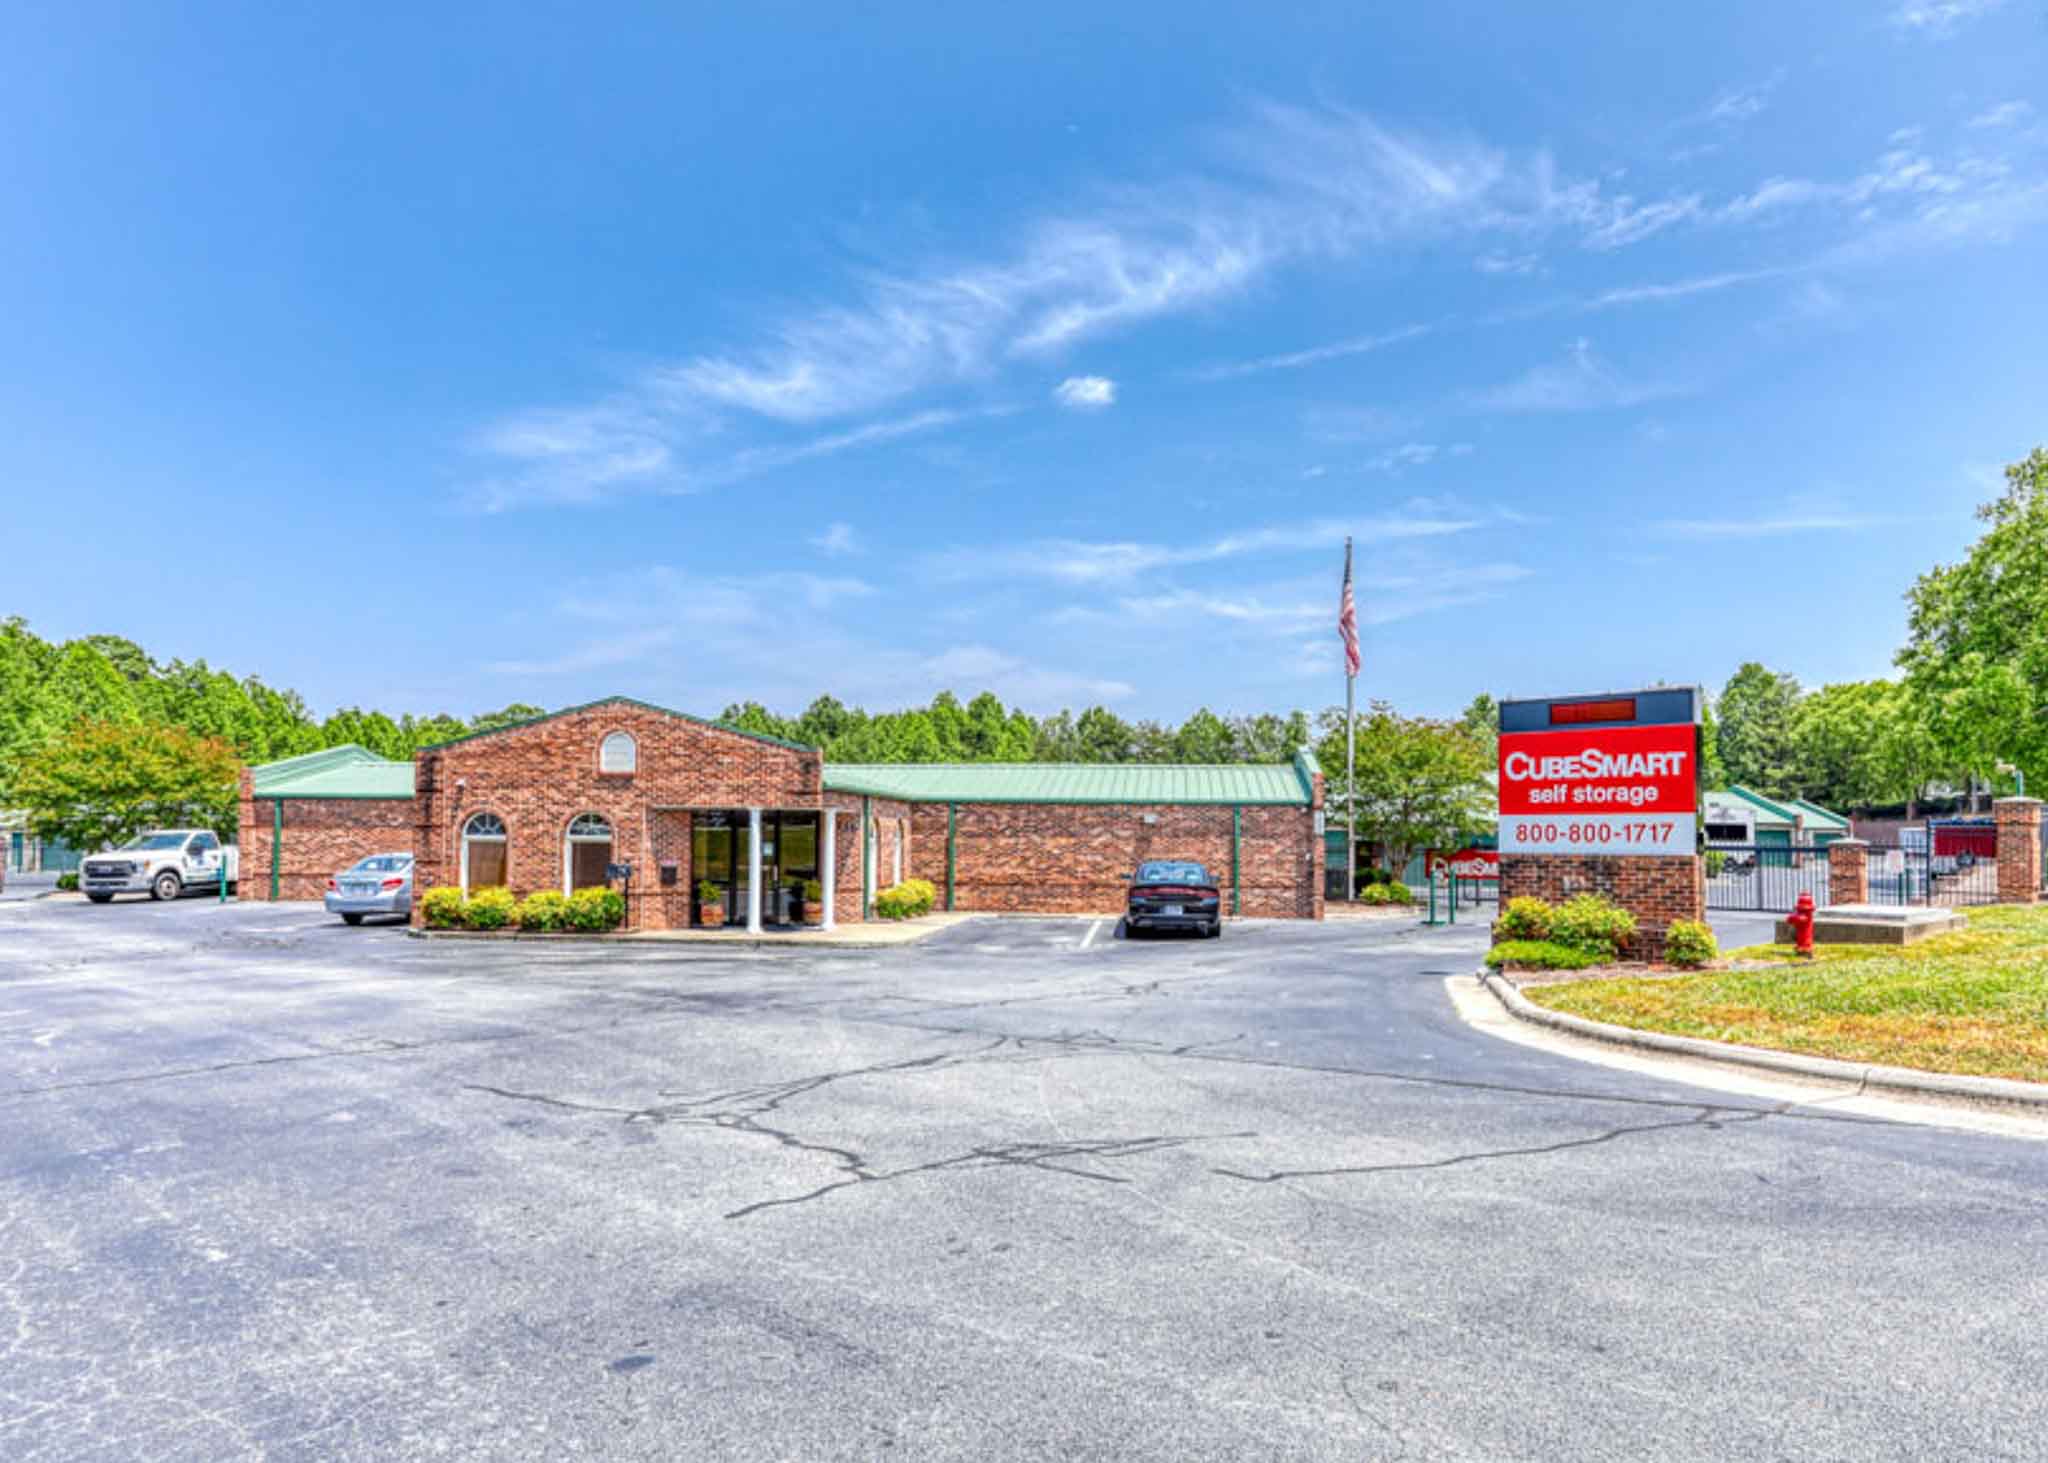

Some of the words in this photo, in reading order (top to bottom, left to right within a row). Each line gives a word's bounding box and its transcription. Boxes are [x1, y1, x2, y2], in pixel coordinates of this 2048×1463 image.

[1529, 784, 1567, 804] self
[1573, 785, 1658, 806] storage
[1516, 823, 1675, 843] 800-800-1717
